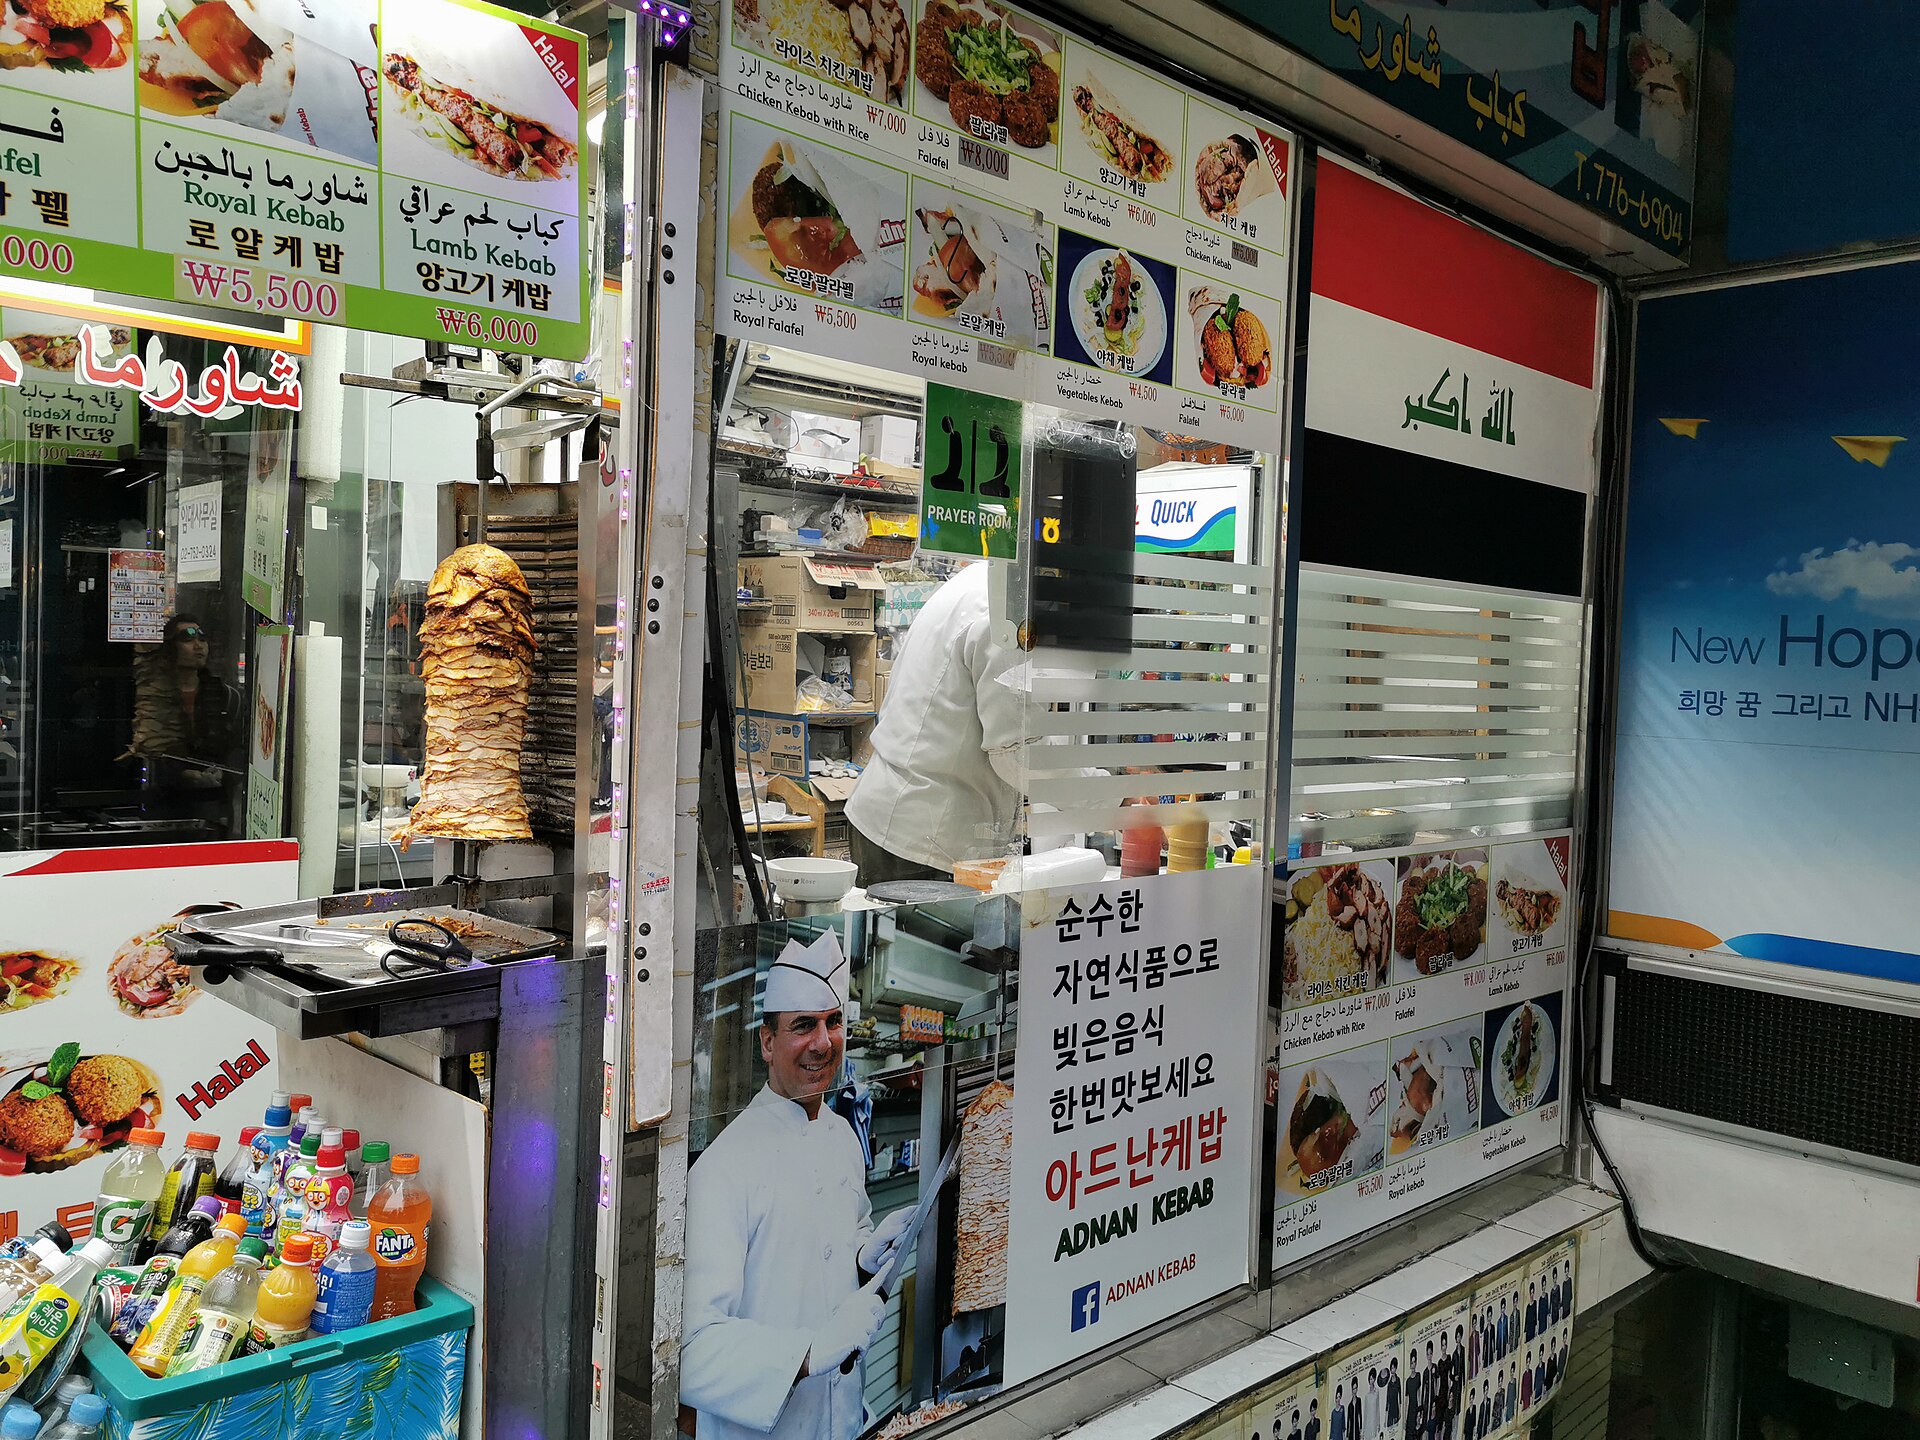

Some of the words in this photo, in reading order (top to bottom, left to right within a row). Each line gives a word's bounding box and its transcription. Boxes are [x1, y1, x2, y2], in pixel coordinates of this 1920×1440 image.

[533, 34, 574, 90] Halal
[765, 68, 780, 84] مع
[775, 37, 817, 70] 라이스
[818, 55, 846, 82] 치킨
[847, 66, 874, 93] 케밥
[784, 75, 815, 101] دجاج
[818, 84, 853, 112] شاورما
[738, 83, 782, 111] Chicken
[786, 99, 820, 124] Kebab
[824, 116, 845, 134] with
[848, 123, 869, 142] Rice
[866, 105, 907, 136] ₩7,000
[1466, 69, 1527, 145] كباب
[918, 125, 950, 148] فلافل
[969, 115, 1008, 145] 팔라펠
[0, 147, 42, 177] fel
[154, 140, 252, 191] بالجبن
[918, 149, 949, 170] Falafel
[961, 138, 1008, 175] ₩8,000
[1263, 137, 1286, 183] Halal
[266, 159, 368, 206] شاورما
[1100, 167, 1127, 191] 양고기
[1128, 177, 1147, 197] 케밥
[184, 180, 256, 217] Royal
[267, 197, 345, 234] Kebab
[399, 185, 455, 223] عراقي
[464, 202, 498, 236] لحم
[1064, 202, 1086, 220] Lamb
[1087, 210, 1111, 228] Kebab
[1128, 203, 1157, 228] ₩6,000
[507, 213, 564, 246] كباب
[1220, 213, 1237, 231] 치킨
[1240, 219, 1257, 239] 케밥
[2, 235, 74, 274] 000
[411, 228, 477, 262] Lamb
[486, 243, 556, 277] Kebab
[1185, 247, 1211, 265] Chicken
[1212, 256, 1232, 271] Kebab
[184, 260, 338, 317] ₩5,500
[416, 262, 494, 302] 양고기
[501, 277, 552, 312] 케밥
[785, 267, 814, 290] 로얄
[815, 275, 855, 300] 팔라펠
[769, 295, 797, 312] فلافل
[815, 304, 857, 331] ₩5,500
[437, 307, 537, 346] ₩6,000
[733, 309, 765, 329] Royal
[768, 318, 804, 337] Falafel
[960, 313, 983, 333] 로얄
[983, 319, 1006, 338] 케밥
[79, 324, 302, 418] شاورما
[912, 351, 937, 366] Royal
[940, 357, 967, 373] kebab
[1096, 350, 1115, 369] 야채
[1116, 355, 1135, 372] 케밥
[1057, 385, 1098, 404] Vegetables
[1100, 395, 1123, 409] Kebab
[1129, 382, 1157, 402] ₩4,500
[1178, 413, 1200, 427] Falafel
[1220, 405, 1245, 423] ₩5,000
[927, 504, 976, 525] PRAYER
[978, 506, 1012, 529] ROOM
[1151, 499, 1197, 526] QUICK
[1671, 626, 1766, 664] New
[1778, 614, 1920, 681] Hop
[1678, 689, 1727, 717] 희망
[1735, 691, 1762, 718] 꿈
[1772, 693, 1851, 721] 그리고
[1550, 840, 1567, 877] Halal
[1055, 888, 1144, 943] 순수한
[1052, 938, 1220, 1006] 자연식품으로
[1307, 980, 1332, 998] 라이스
[1335, 976, 1350, 992] 치킨
[1351, 971, 1369, 989] 케밥
[1365, 993, 1390, 1013] ₩7,000
[1489, 986, 1503, 996] Lamb
[1504, 981, 1520, 992] Kebab
[1395, 1007, 1415, 1021] Falafel
[1052, 1004, 1164, 1071] 빚은음식
[1283, 1033, 1311, 1051] Chicken
[1312, 1028, 1335, 1044] Kebab
[1336, 1024, 1350, 1038] with
[1351, 1021, 1365, 1034] Rice
[175, 1038, 272, 1122] Halal
[1049, 1051, 1216, 1134] 한번맛보세요
[1420, 1131, 1435, 1146] 로얄
[1482, 1145, 1510, 1160] Vegetables
[1510, 1135, 1526, 1149] Kebab
[1045, 1105, 1228, 1210] 아드난케밥
[1310, 1172, 1327, 1190] 로얄
[1388, 1188, 1406, 1200] Royal
[1406, 1178, 1425, 1192] kebab
[1054, 1202, 1138, 1262] ADNAN
[1151, 1176, 1215, 1226] KEBAB
[1276, 1234, 1297, 1248] Royal
[1298, 1220, 1321, 1239] Falafel
[376, 1233, 415, 1252] FANTA
[1105, 1268, 1155, 1306] ADNAN
[1157, 1252, 1196, 1287] KEBAB
[29, 1311, 58, 1337] 에이드
[42, 1304, 63, 1325] 레몬
